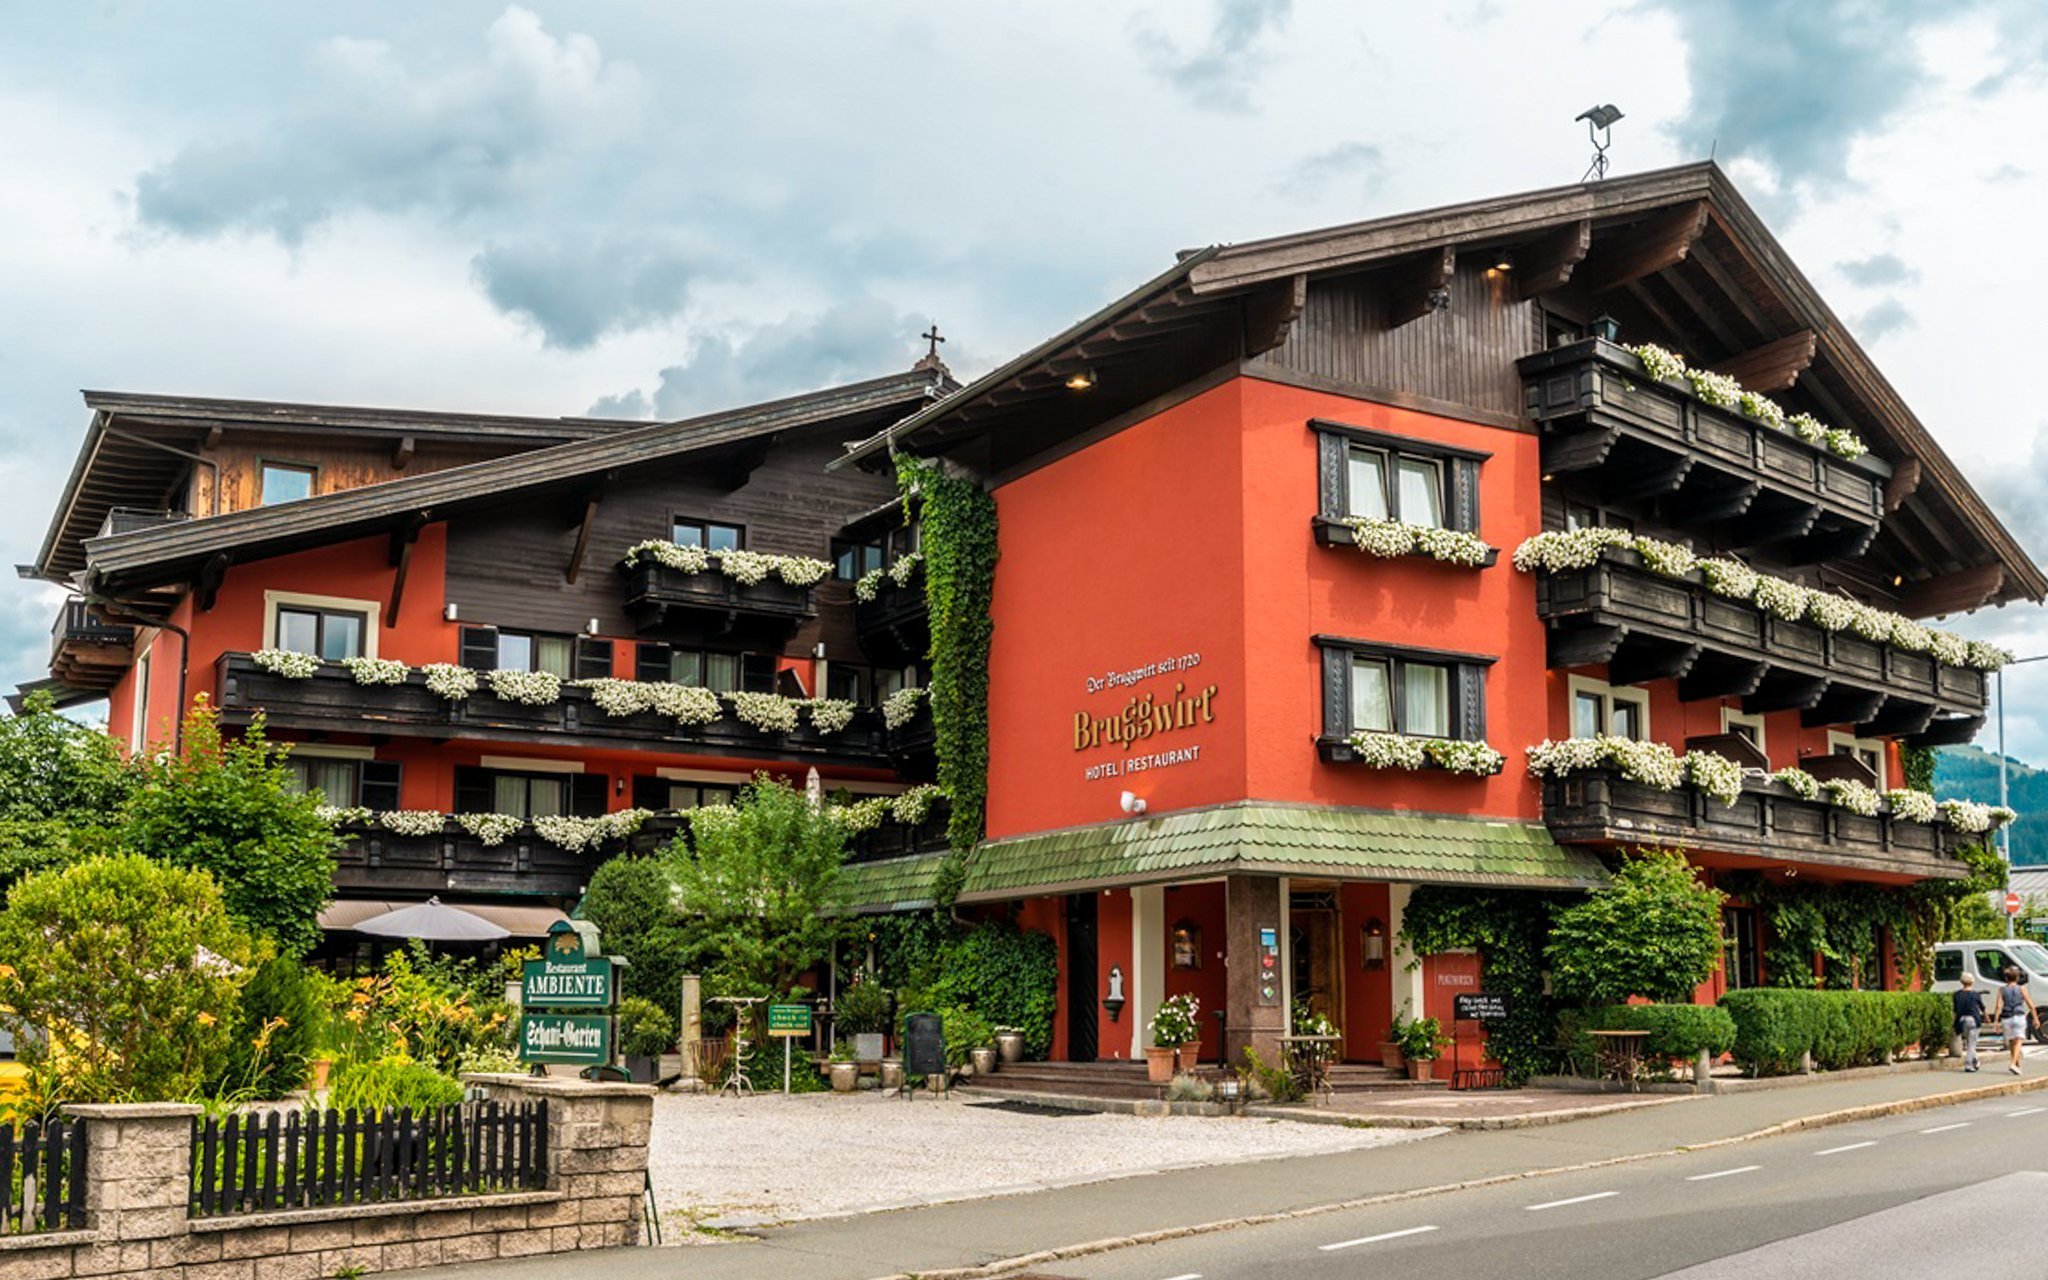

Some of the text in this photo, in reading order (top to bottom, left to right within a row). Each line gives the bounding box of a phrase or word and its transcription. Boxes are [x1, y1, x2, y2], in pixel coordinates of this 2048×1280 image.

[1086, 676, 1105, 694] Der
[1158, 657, 1175, 675] seit
[1176, 652, 1201, 672] 1720
[1073, 682, 1218, 751] Bruggwirt
[1085, 745, 1200, 780] HOTEL RESTAURANT
[526, 974, 605, 994] AMBIENTE
[545, 961, 587, 974] Restaurant
